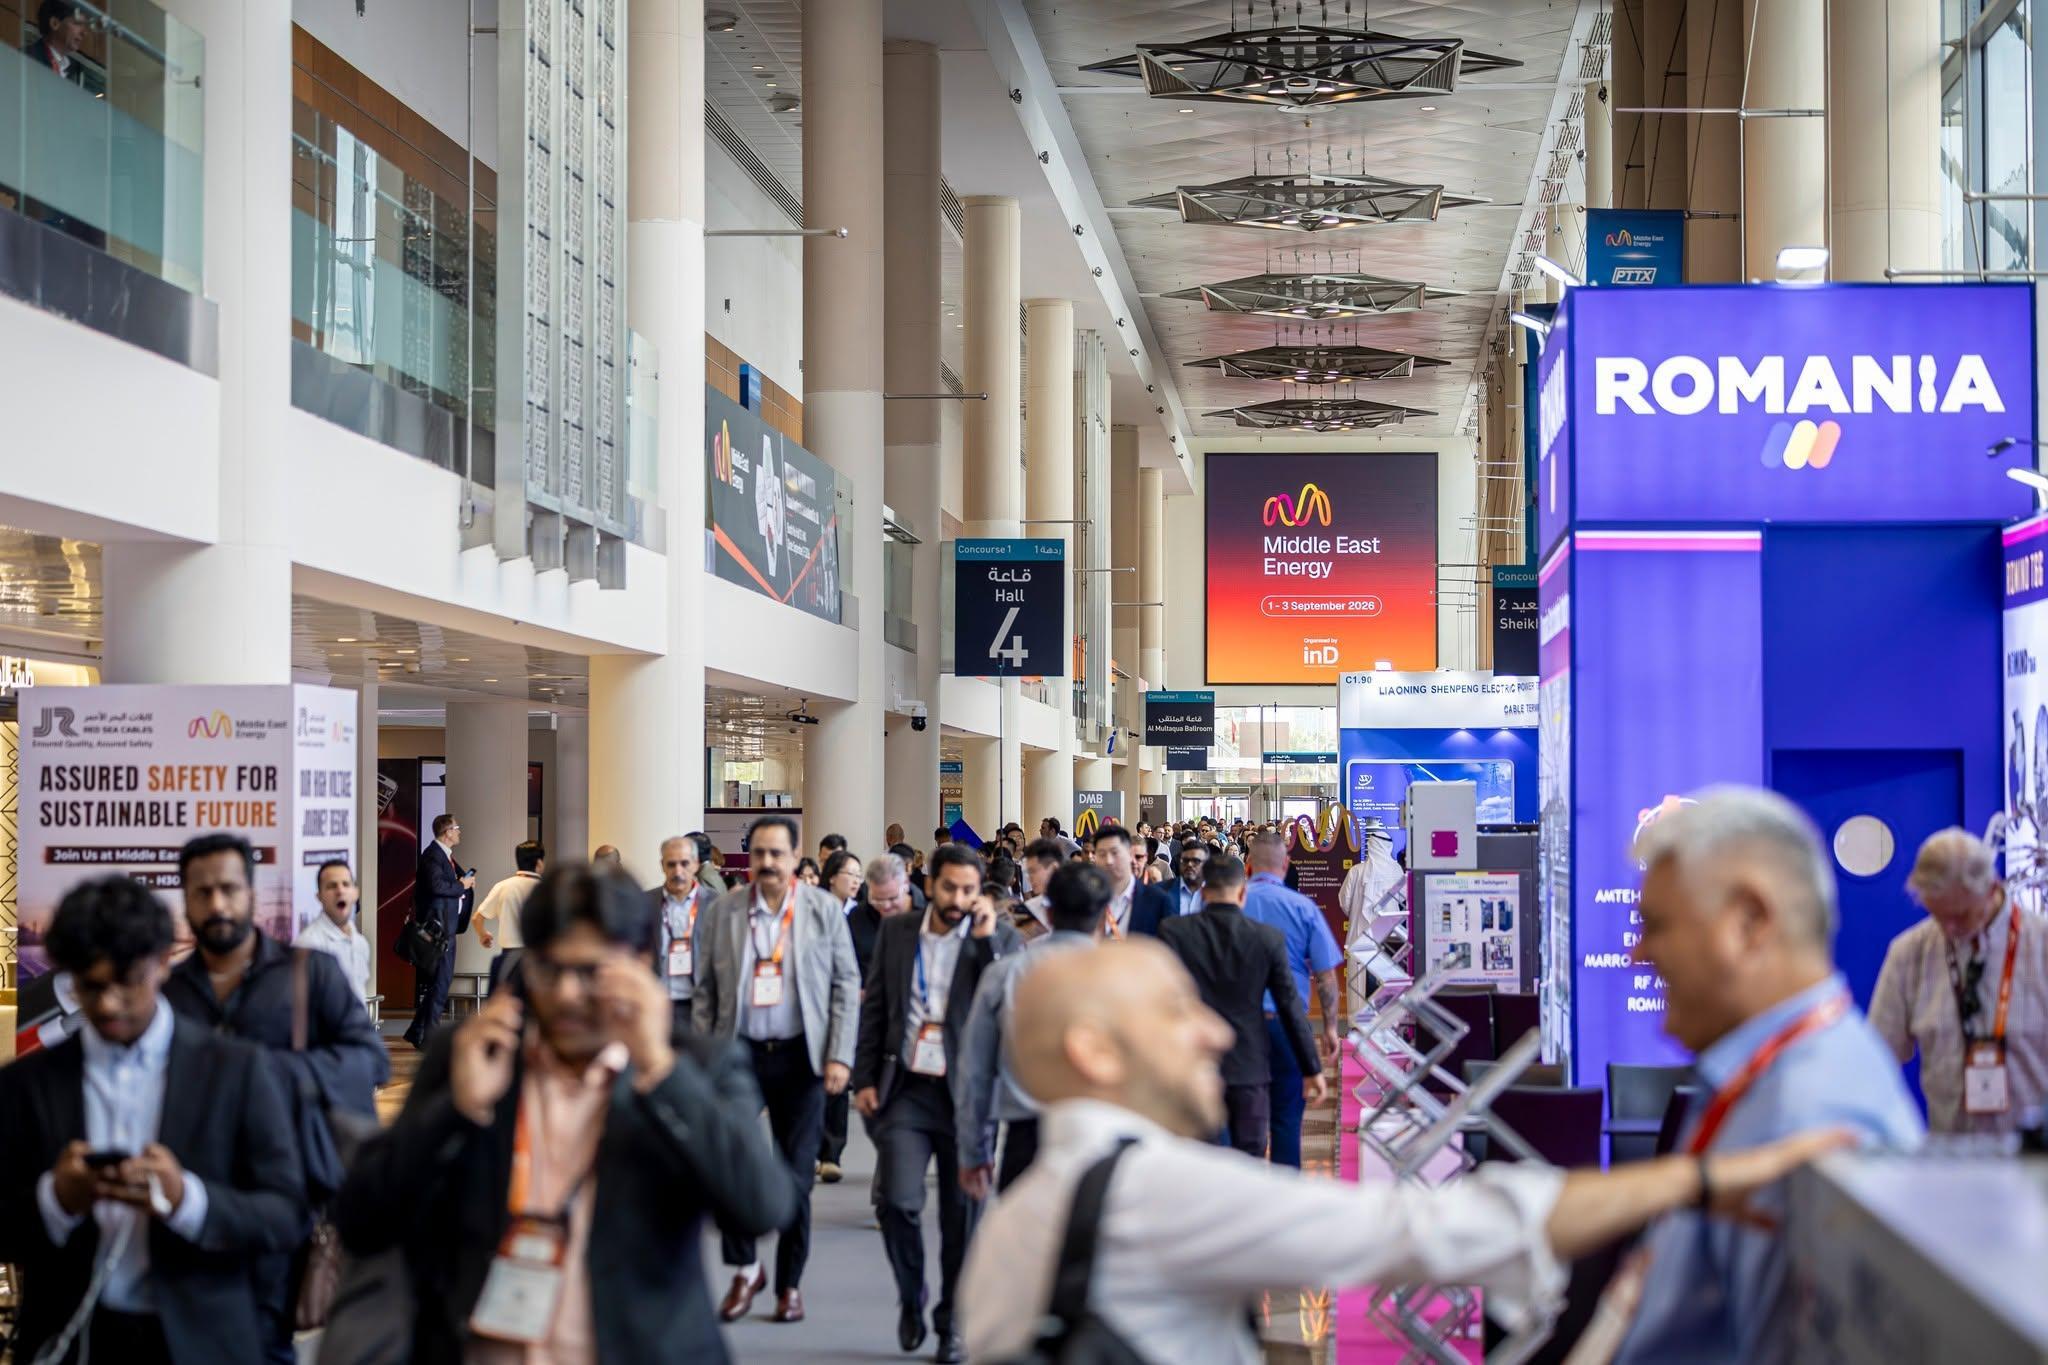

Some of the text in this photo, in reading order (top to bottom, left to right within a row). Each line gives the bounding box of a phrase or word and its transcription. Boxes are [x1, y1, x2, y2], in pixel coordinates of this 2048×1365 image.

[1615, 270, 1653, 281] PTTX
[1595, 354, 2005, 416] ROMANIA
[958, 545, 1011, 554] Concourse 1
[1263, 536, 1380, 554] Middle East
[988, 567, 1032, 582] قاعة
[1263, 558, 1333, 579] Energy
[995, 589, 1025, 602] Hall
[1268, 602, 1273, 610] 1
[1282, 602, 1289, 610] 3
[1291, 602, 1345, 612] September
[1348, 602, 1375, 610] 2026
[989, 607, 1029, 667] 4
[1304, 646, 1339, 665] inD
[1345, 676, 1372, 684] C1.90
[1379, 685, 1427, 695] LIAONING
[1431, 684, 1479, 694] SHENPENG
[1481, 683, 1516, 694] ELECTRIC
[1504, 704, 1525, 714] CABLE
[236, 720, 288, 728] Middle East
[1155, 725, 1183, 733] Multaqua
[236, 731, 267, 740] Energy
[40, 765, 278, 791] ASSURED SAFETY FOR
[1079, 793, 1103, 804] DMB
[40, 801, 278, 827] SUSTAINABLE FUTURE
[53, 848, 80, 862] Join
[82, 848, 97, 861] Us
[100, 849, 113, 861] at
[115, 848, 156, 861] Middle
